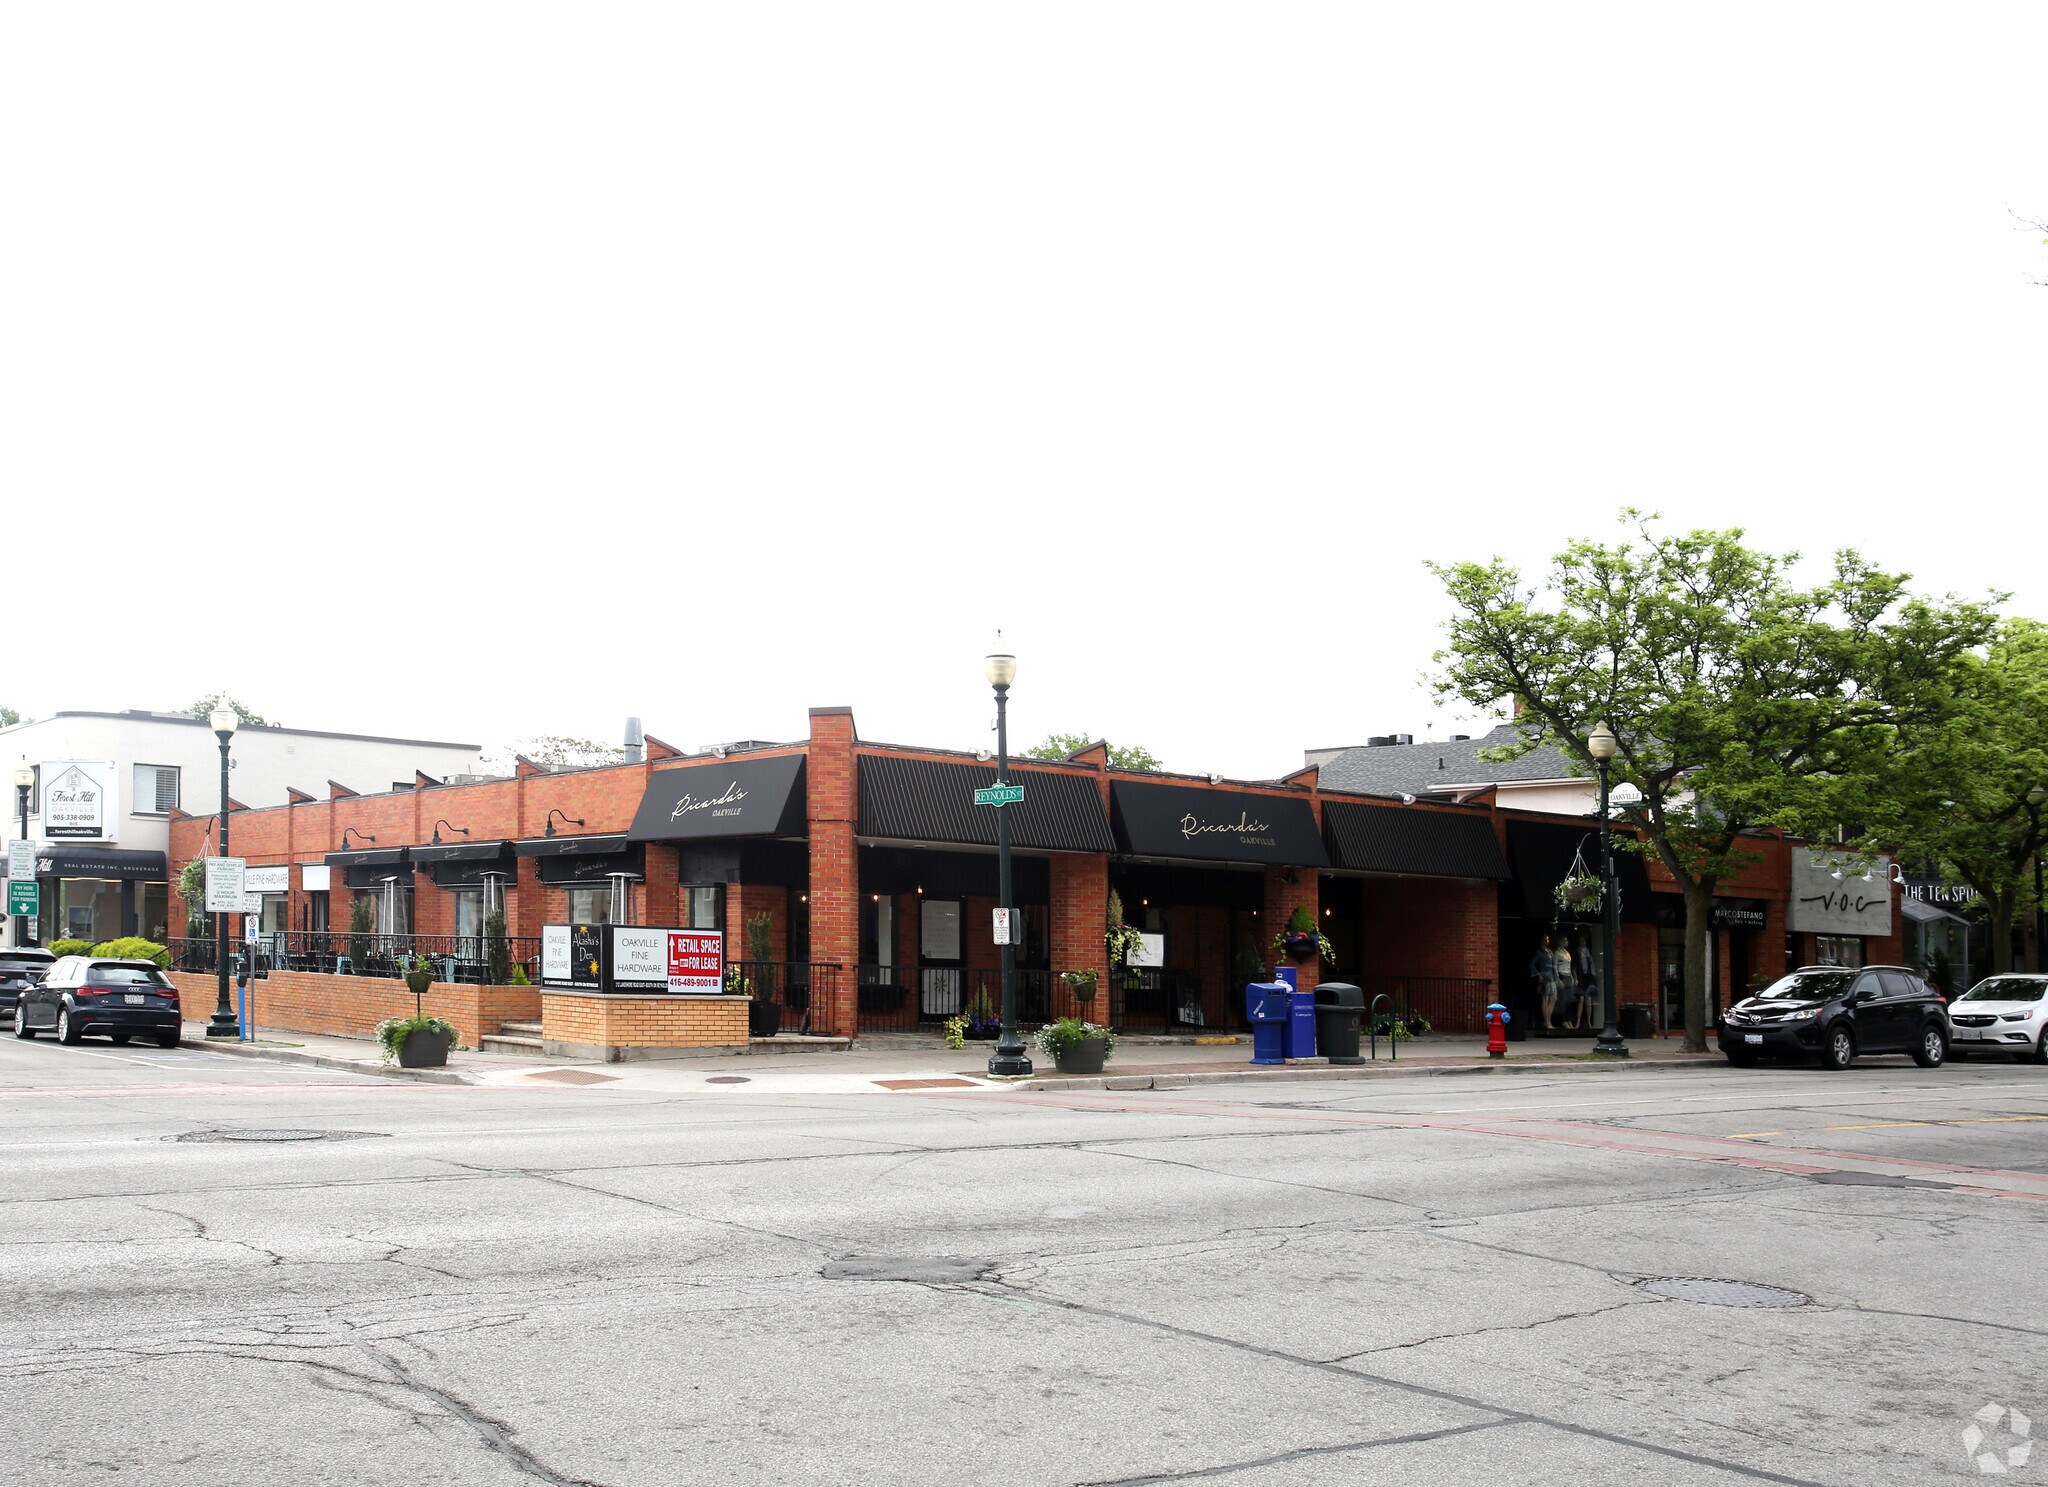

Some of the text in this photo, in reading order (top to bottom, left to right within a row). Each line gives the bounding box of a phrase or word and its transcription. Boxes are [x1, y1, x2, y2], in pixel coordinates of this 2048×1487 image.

[52, 790, 96, 802] Forest Hill
[670, 780, 749, 822] Ricarda's
[976, 790, 1016, 802] REYNOLDS
[712, 808, 742, 817] OAKVILLE
[1180, 811, 1270, 840] Ricarda's
[1240, 836, 1276, 846] OAKVILLE
[37, 858, 54, 872] Hill
[1904, 884, 1923, 902] THE
[1928, 885, 1949, 902] TEN
[1715, 910, 1764, 920] MARCOSTEFANO
[548, 935, 566, 944] OAKVILLE
[622, 938, 658, 948] OAKVILLE
[678, 938, 720, 954] RETAIL SPACE
[552, 948, 562, 956] FINE
[580, 947, 594, 962] Den
[632, 951, 649, 960] FINE
[546, 960, 569, 970] HARDWARE
[689, 956, 700, 969] FOR
[701, 957, 718, 970] LEASE
[617, 964, 662, 973] HARDWARE
[669, 978, 711, 987] 416-489-9001
